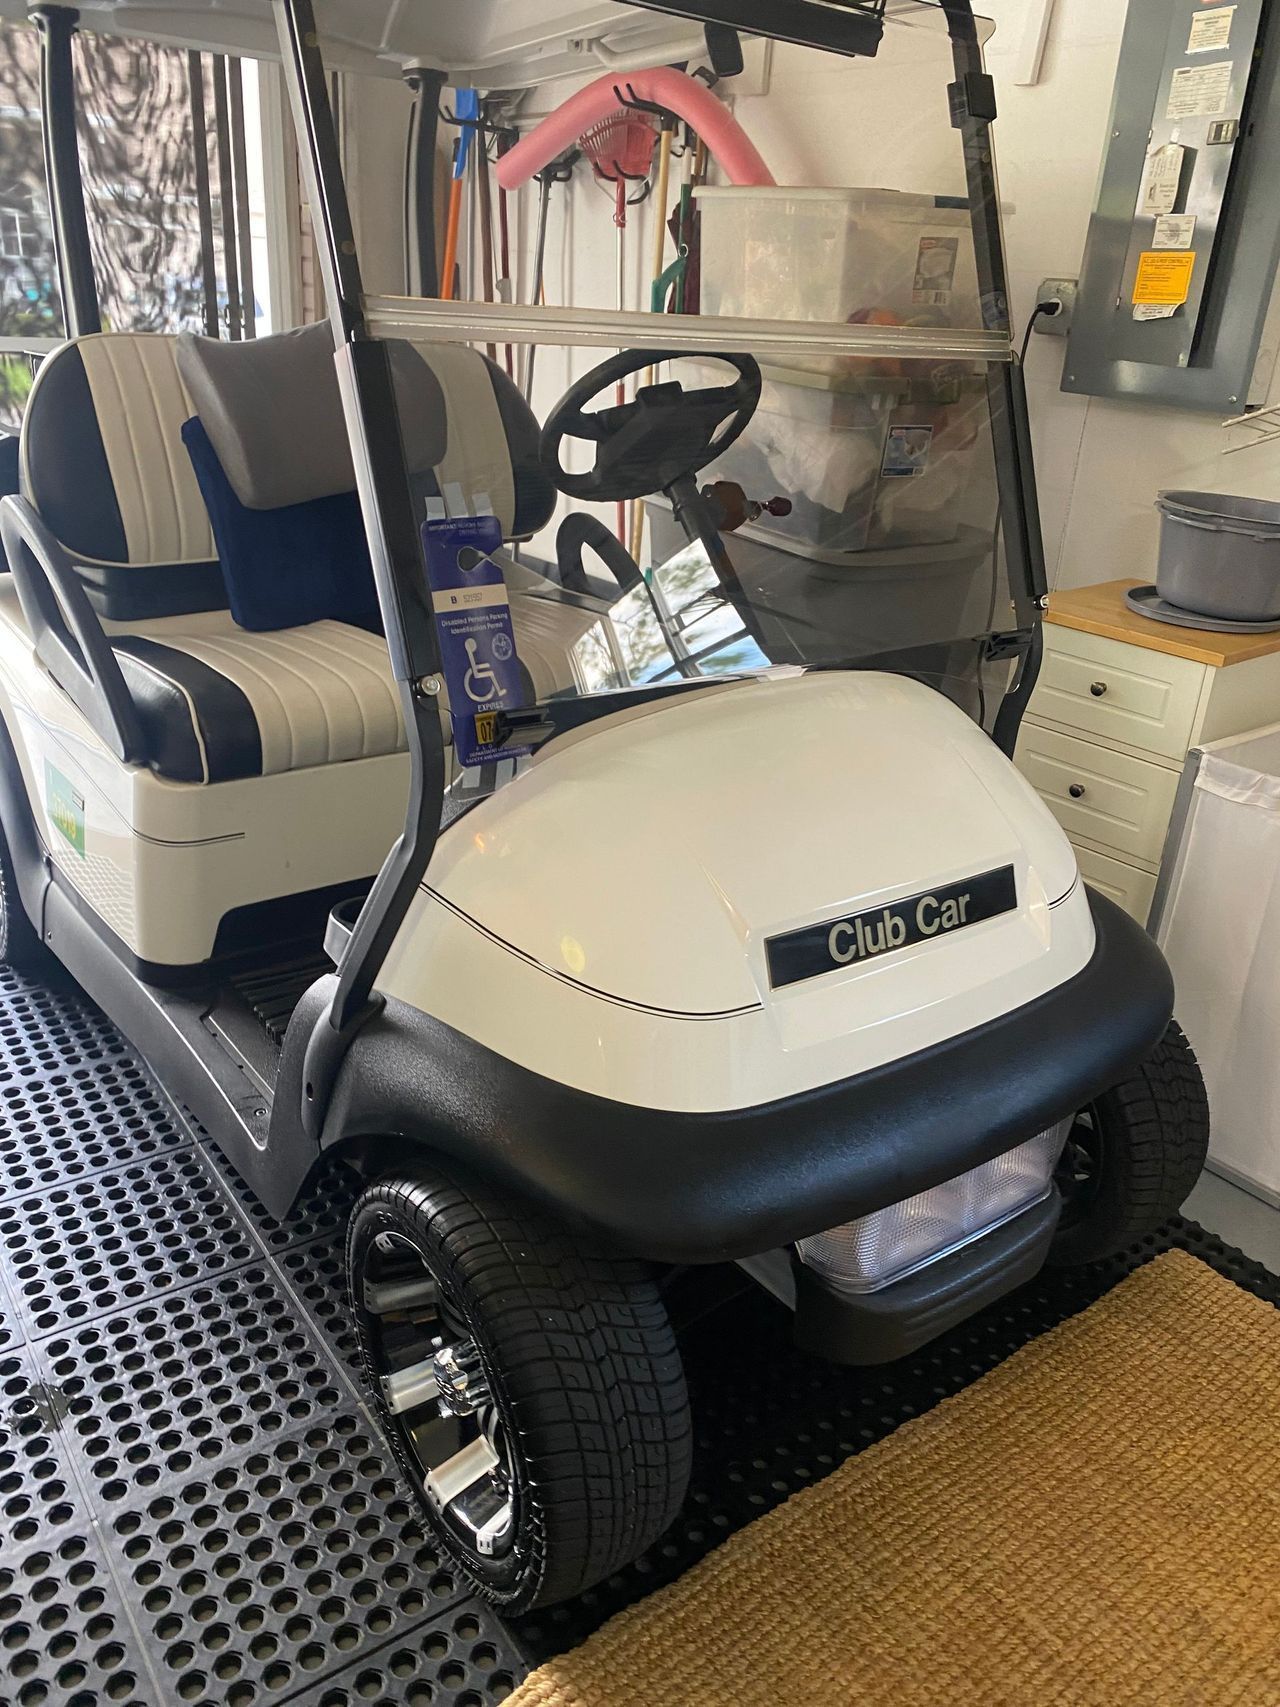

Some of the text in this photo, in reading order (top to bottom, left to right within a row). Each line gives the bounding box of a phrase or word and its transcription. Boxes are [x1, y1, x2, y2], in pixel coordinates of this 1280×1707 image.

[450, 595, 458, 605] B
[441, 617, 468, 627] Disabled
[490, 612, 508, 620] Parking
[487, 621, 503, 630] Permit
[477, 701, 504, 712] EXPIRES
[828, 893, 970, 963] Club Car
